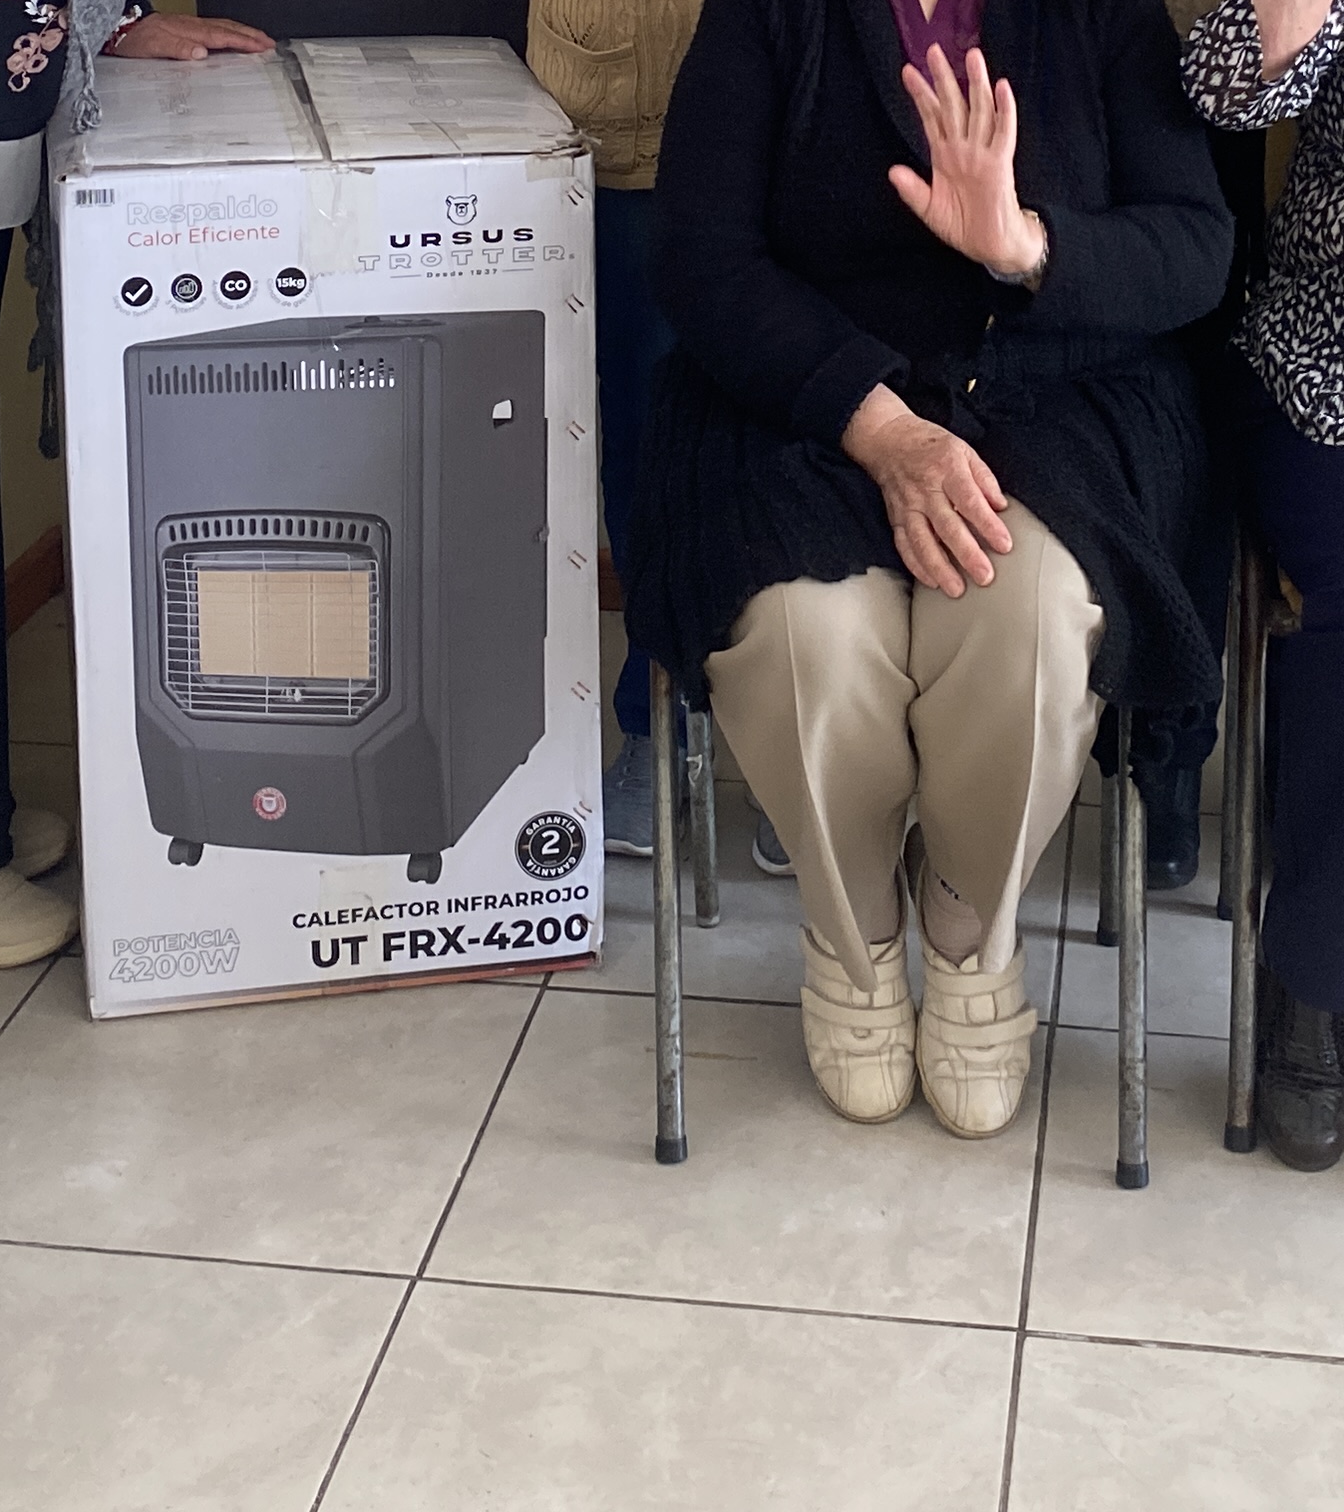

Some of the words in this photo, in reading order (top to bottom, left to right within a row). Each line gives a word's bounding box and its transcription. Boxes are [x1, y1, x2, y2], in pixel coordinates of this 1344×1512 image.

[127, 194, 278, 226] Respaldo
[127, 229, 182, 248] Calor
[189, 225, 280, 245] Eficiente
[389, 228, 534, 249] URSUS
[358, 245, 565, 271] TROTTER
[224, 280, 247, 292] CO
[277, 277, 305, 289] 15kg
[525, 816, 576, 835] GARANTÍA
[541, 830, 560, 855] 2
[526, 856, 576, 877] GARANTÍA
[292, 899, 439, 929] CALEFACTOR
[447, 885, 590, 915] INFRARROJO
[113, 927, 240, 957] POTENCIA
[311, 934, 368, 968] UT
[383, 913, 589, 962] FRX-4200
[109, 946, 240, 983] 4200W
